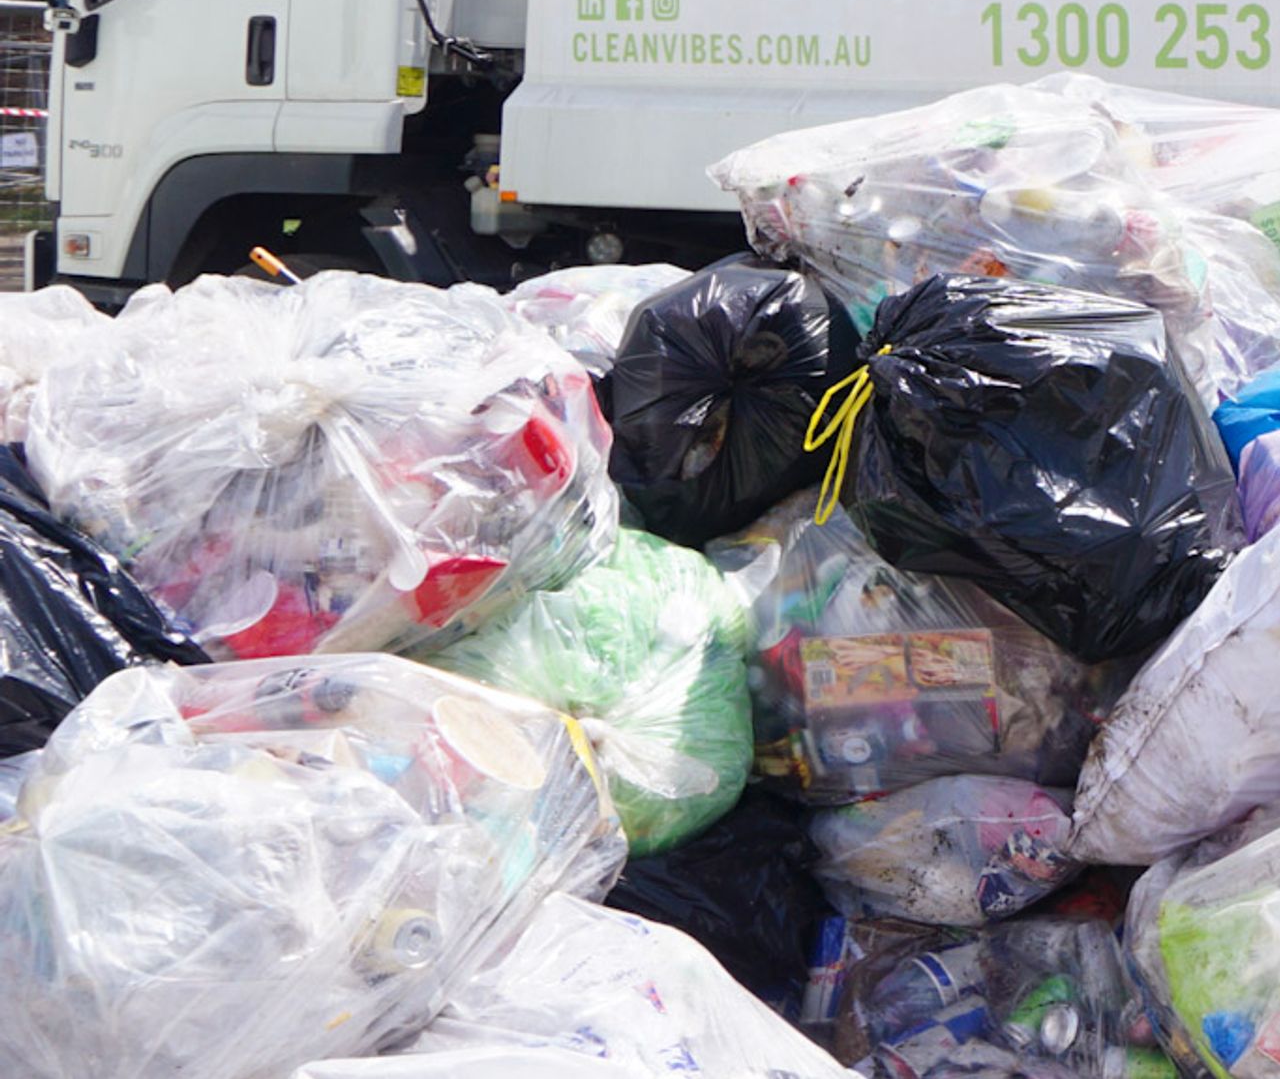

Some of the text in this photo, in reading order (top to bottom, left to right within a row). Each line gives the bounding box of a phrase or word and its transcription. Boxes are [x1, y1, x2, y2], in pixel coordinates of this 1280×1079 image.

[571, 32, 871, 68] CLEANVIBES.COM.AU
[979, 2, 1131, 69] 1300
[1154, 3, 1271, 71] 253
